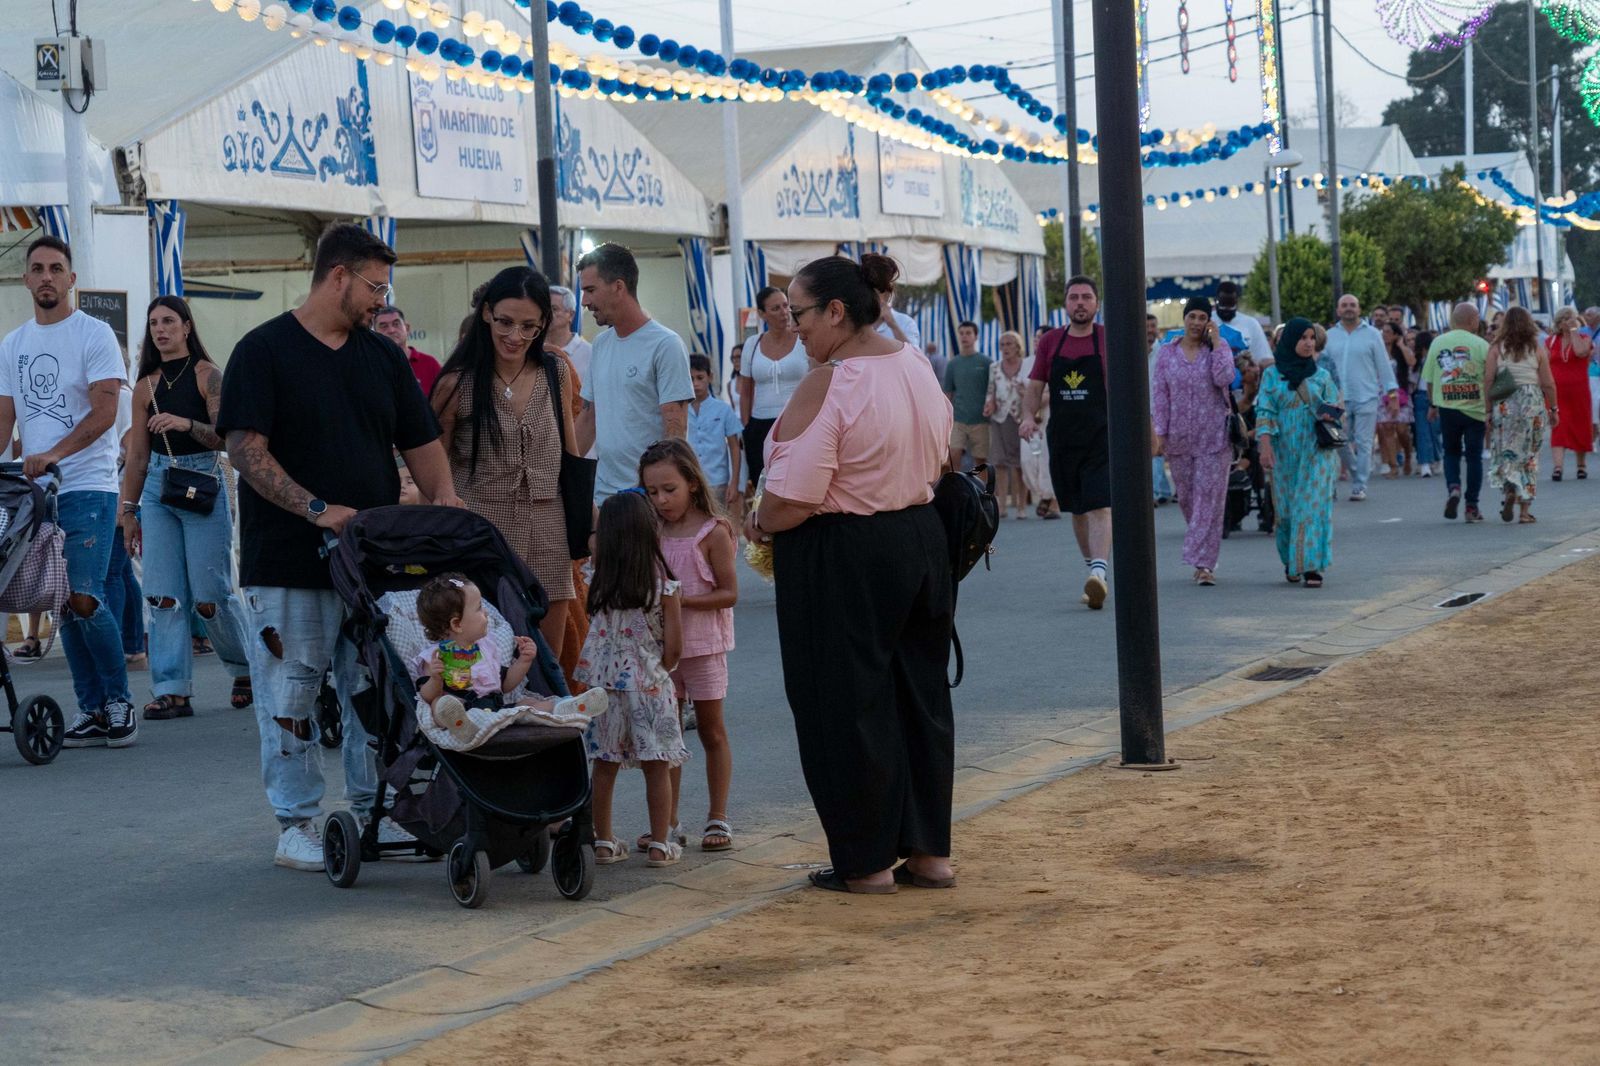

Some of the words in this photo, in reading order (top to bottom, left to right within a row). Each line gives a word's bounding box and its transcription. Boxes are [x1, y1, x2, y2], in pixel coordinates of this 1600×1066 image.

[446, 74, 475, 98] REAL
[479, 81, 504, 103] CLUB
[439, 107, 498, 136] MARÍTIMO
[501, 117, 515, 138] DE
[459, 146, 503, 171] HUELVA
[513, 178, 523, 192] 37
[80, 295, 120, 310] ENTRADA
